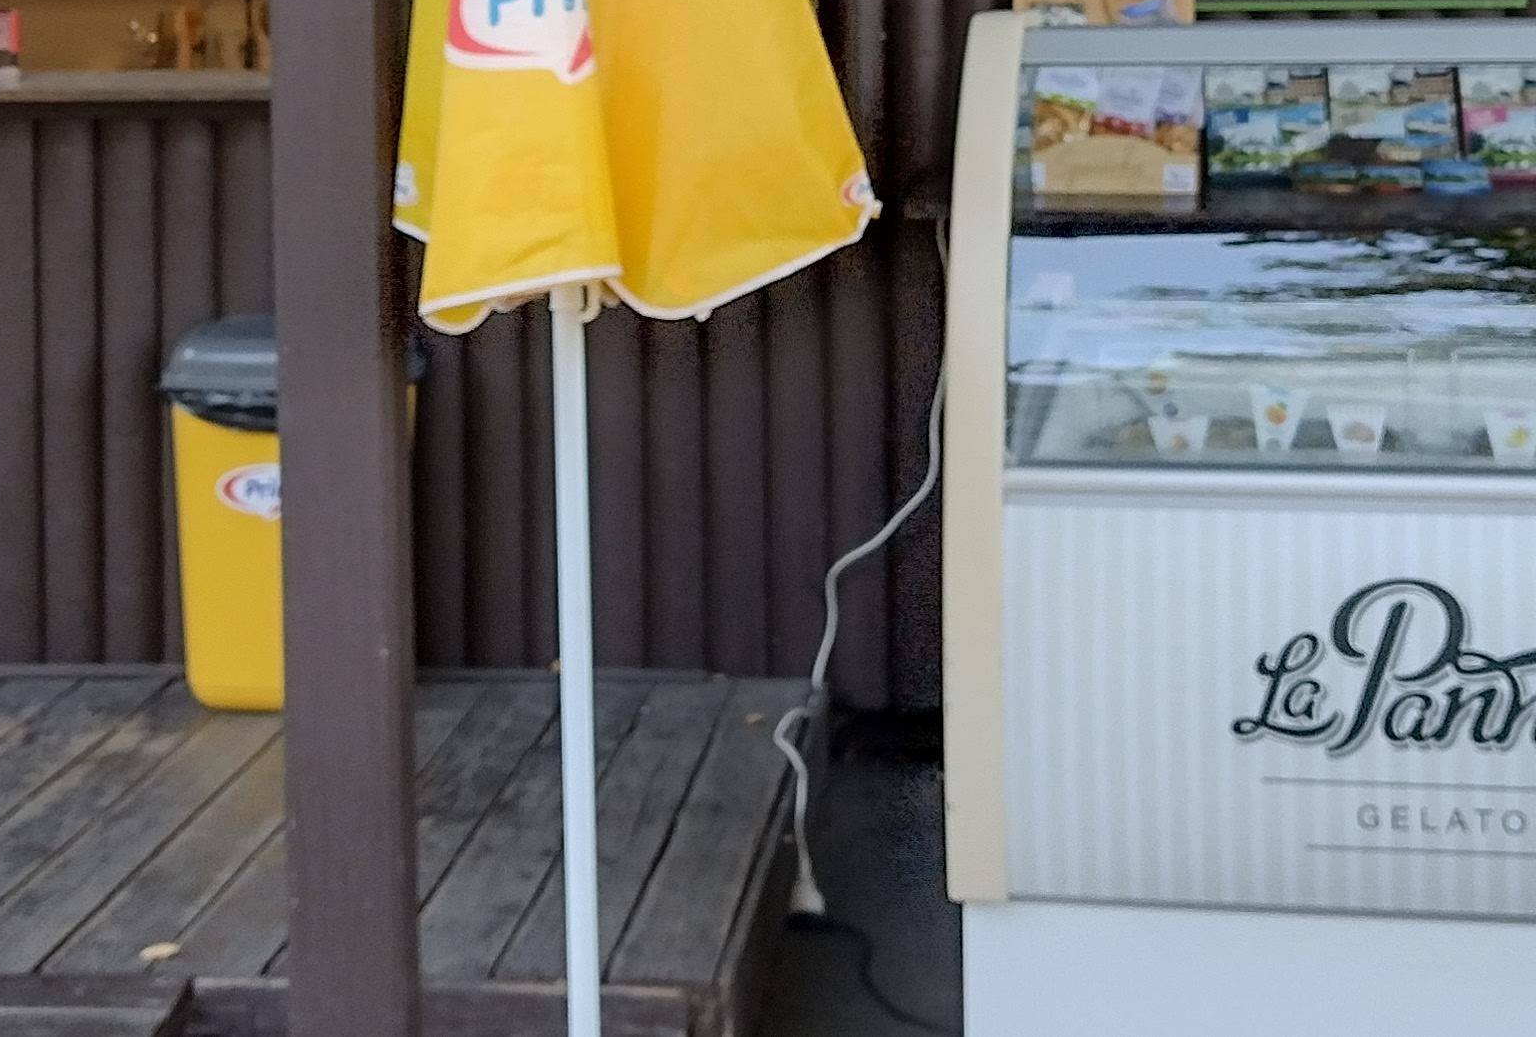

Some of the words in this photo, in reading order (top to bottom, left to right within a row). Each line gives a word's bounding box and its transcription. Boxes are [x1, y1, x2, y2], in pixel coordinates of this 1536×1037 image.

[247, 478, 279, 498] Pri
[1231, 633, 1342, 739] La
[1357, 803, 1529, 836] GELATO
